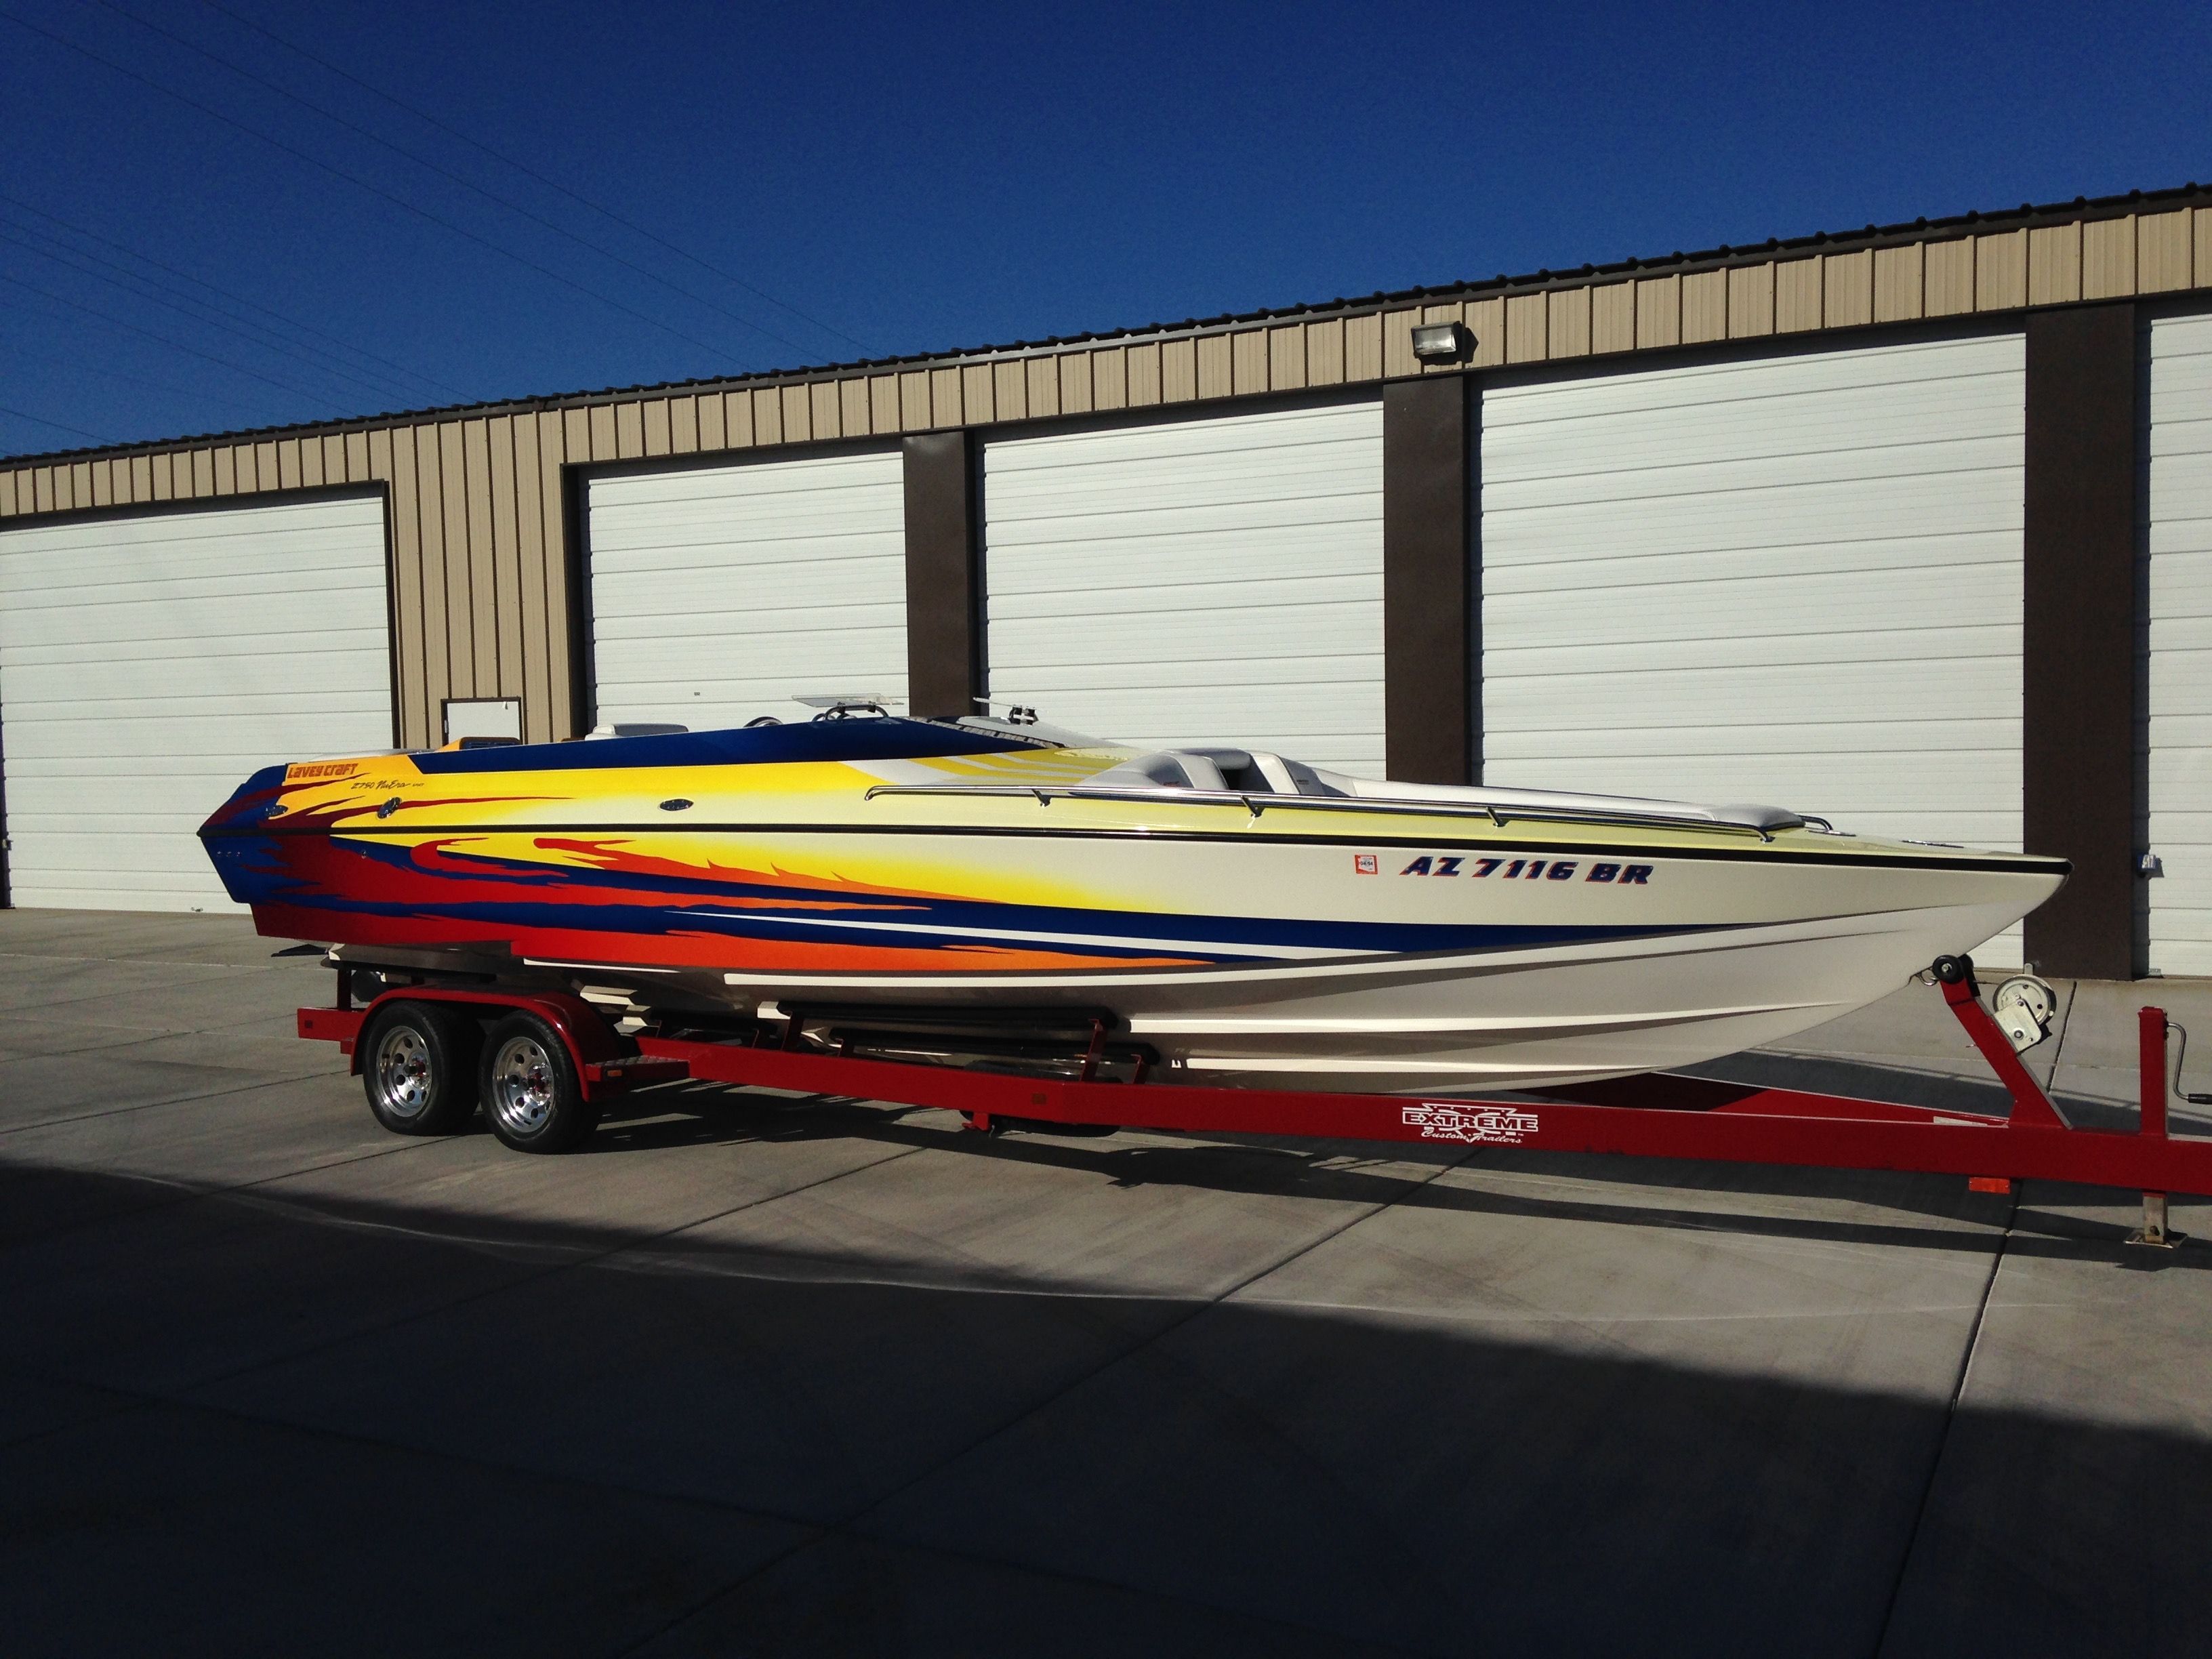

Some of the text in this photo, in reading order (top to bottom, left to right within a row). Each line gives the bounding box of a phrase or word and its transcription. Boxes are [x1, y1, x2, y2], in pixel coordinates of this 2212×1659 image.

[351, 781, 375, 790] 2750
[1399, 856, 1654, 885] AZ 7116 BR
[1402, 1111, 1538, 1132] EXTREME
[1421, 1128, 1522, 1144] Custom Trailers
